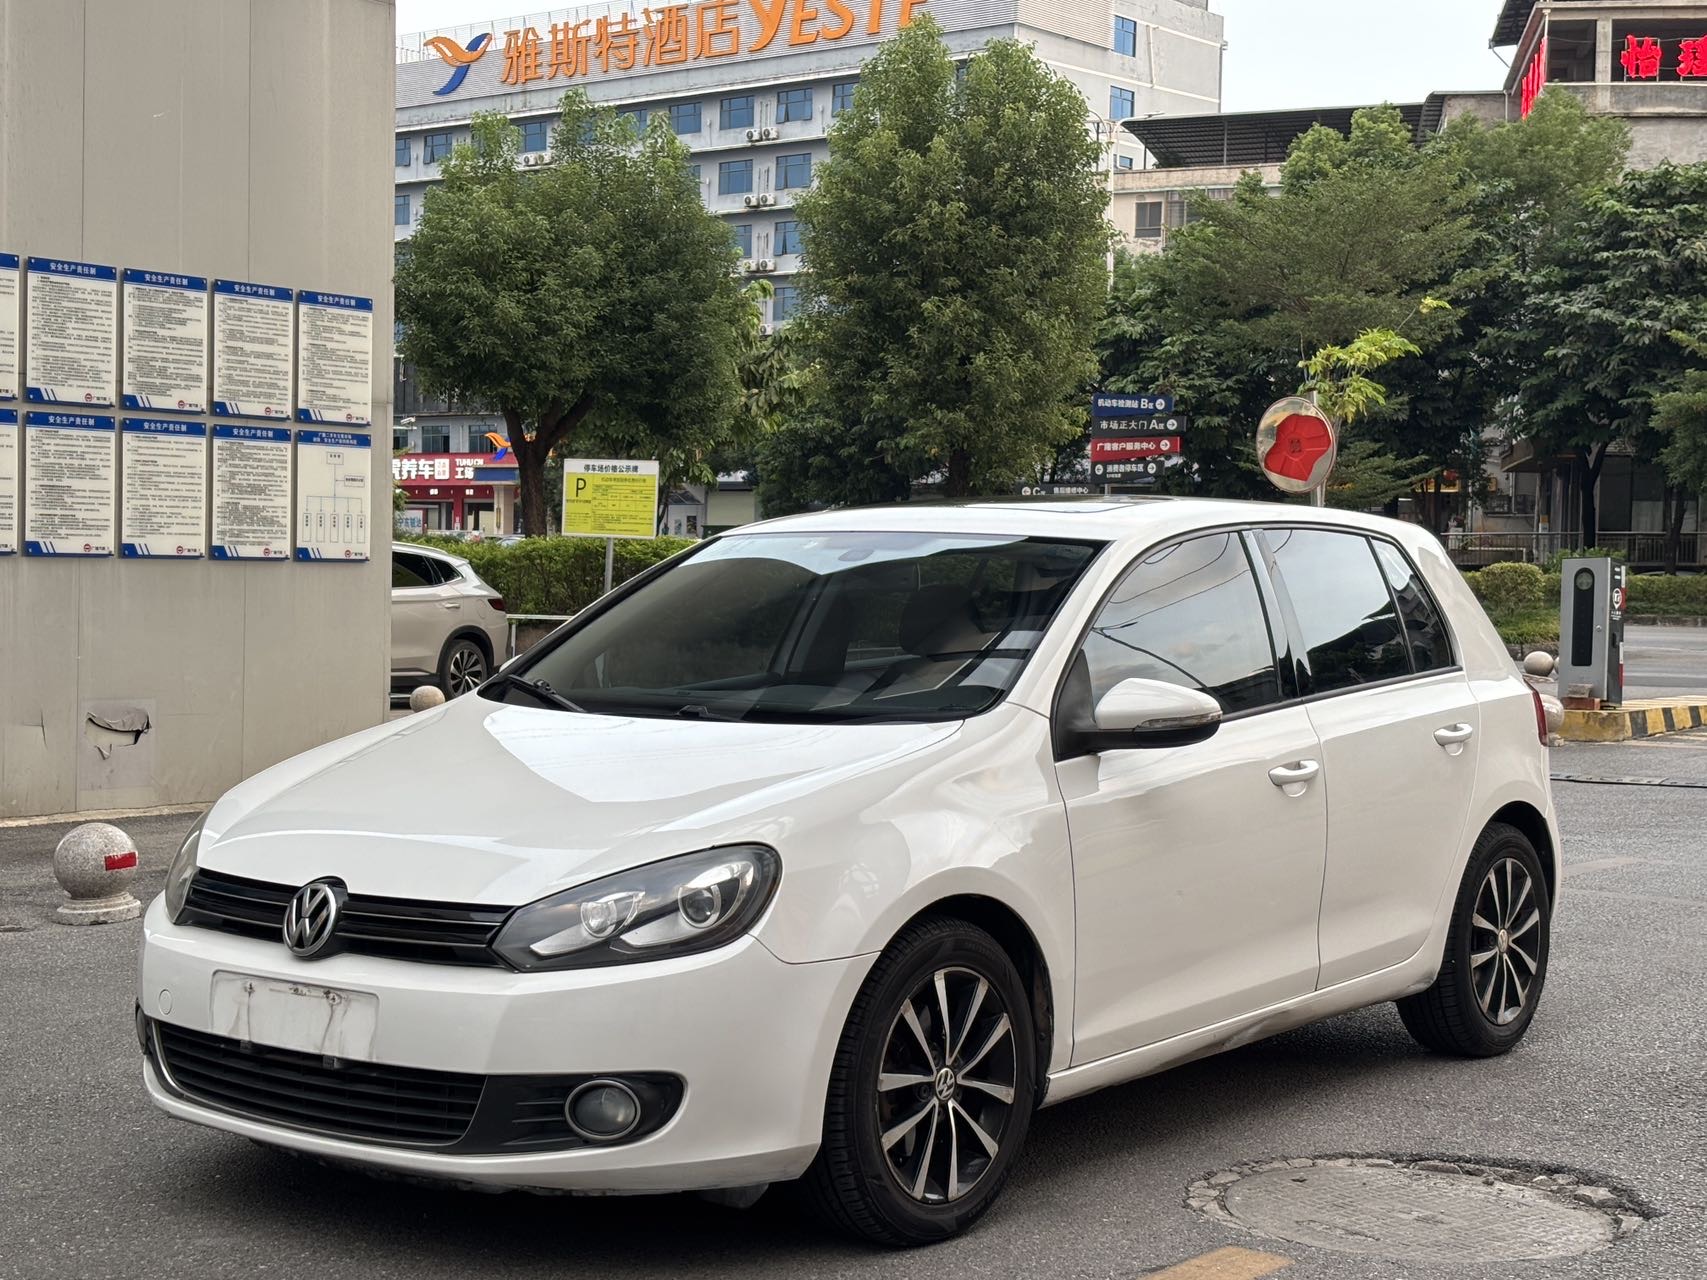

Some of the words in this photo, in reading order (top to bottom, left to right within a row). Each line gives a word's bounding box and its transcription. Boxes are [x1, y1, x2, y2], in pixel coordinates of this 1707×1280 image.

[501, 0, 741, 86] 雅斯特酒店
[49, 262, 97, 276] 安全生产责任制
[144, 273, 188, 286] 安全生产责任制
[234, 284, 276, 297] 安全生产责任制
[317, 294, 356, 307] 安全生产责任制
[48, 415, 96, 427] 安全生产责任制
[143, 421, 187, 432] 安全生产责任制
[1100, 420, 1147, 430] 市场正大门
[232, 428, 274, 439] 安全生产责任制
[576, 477, 587, 498] P
